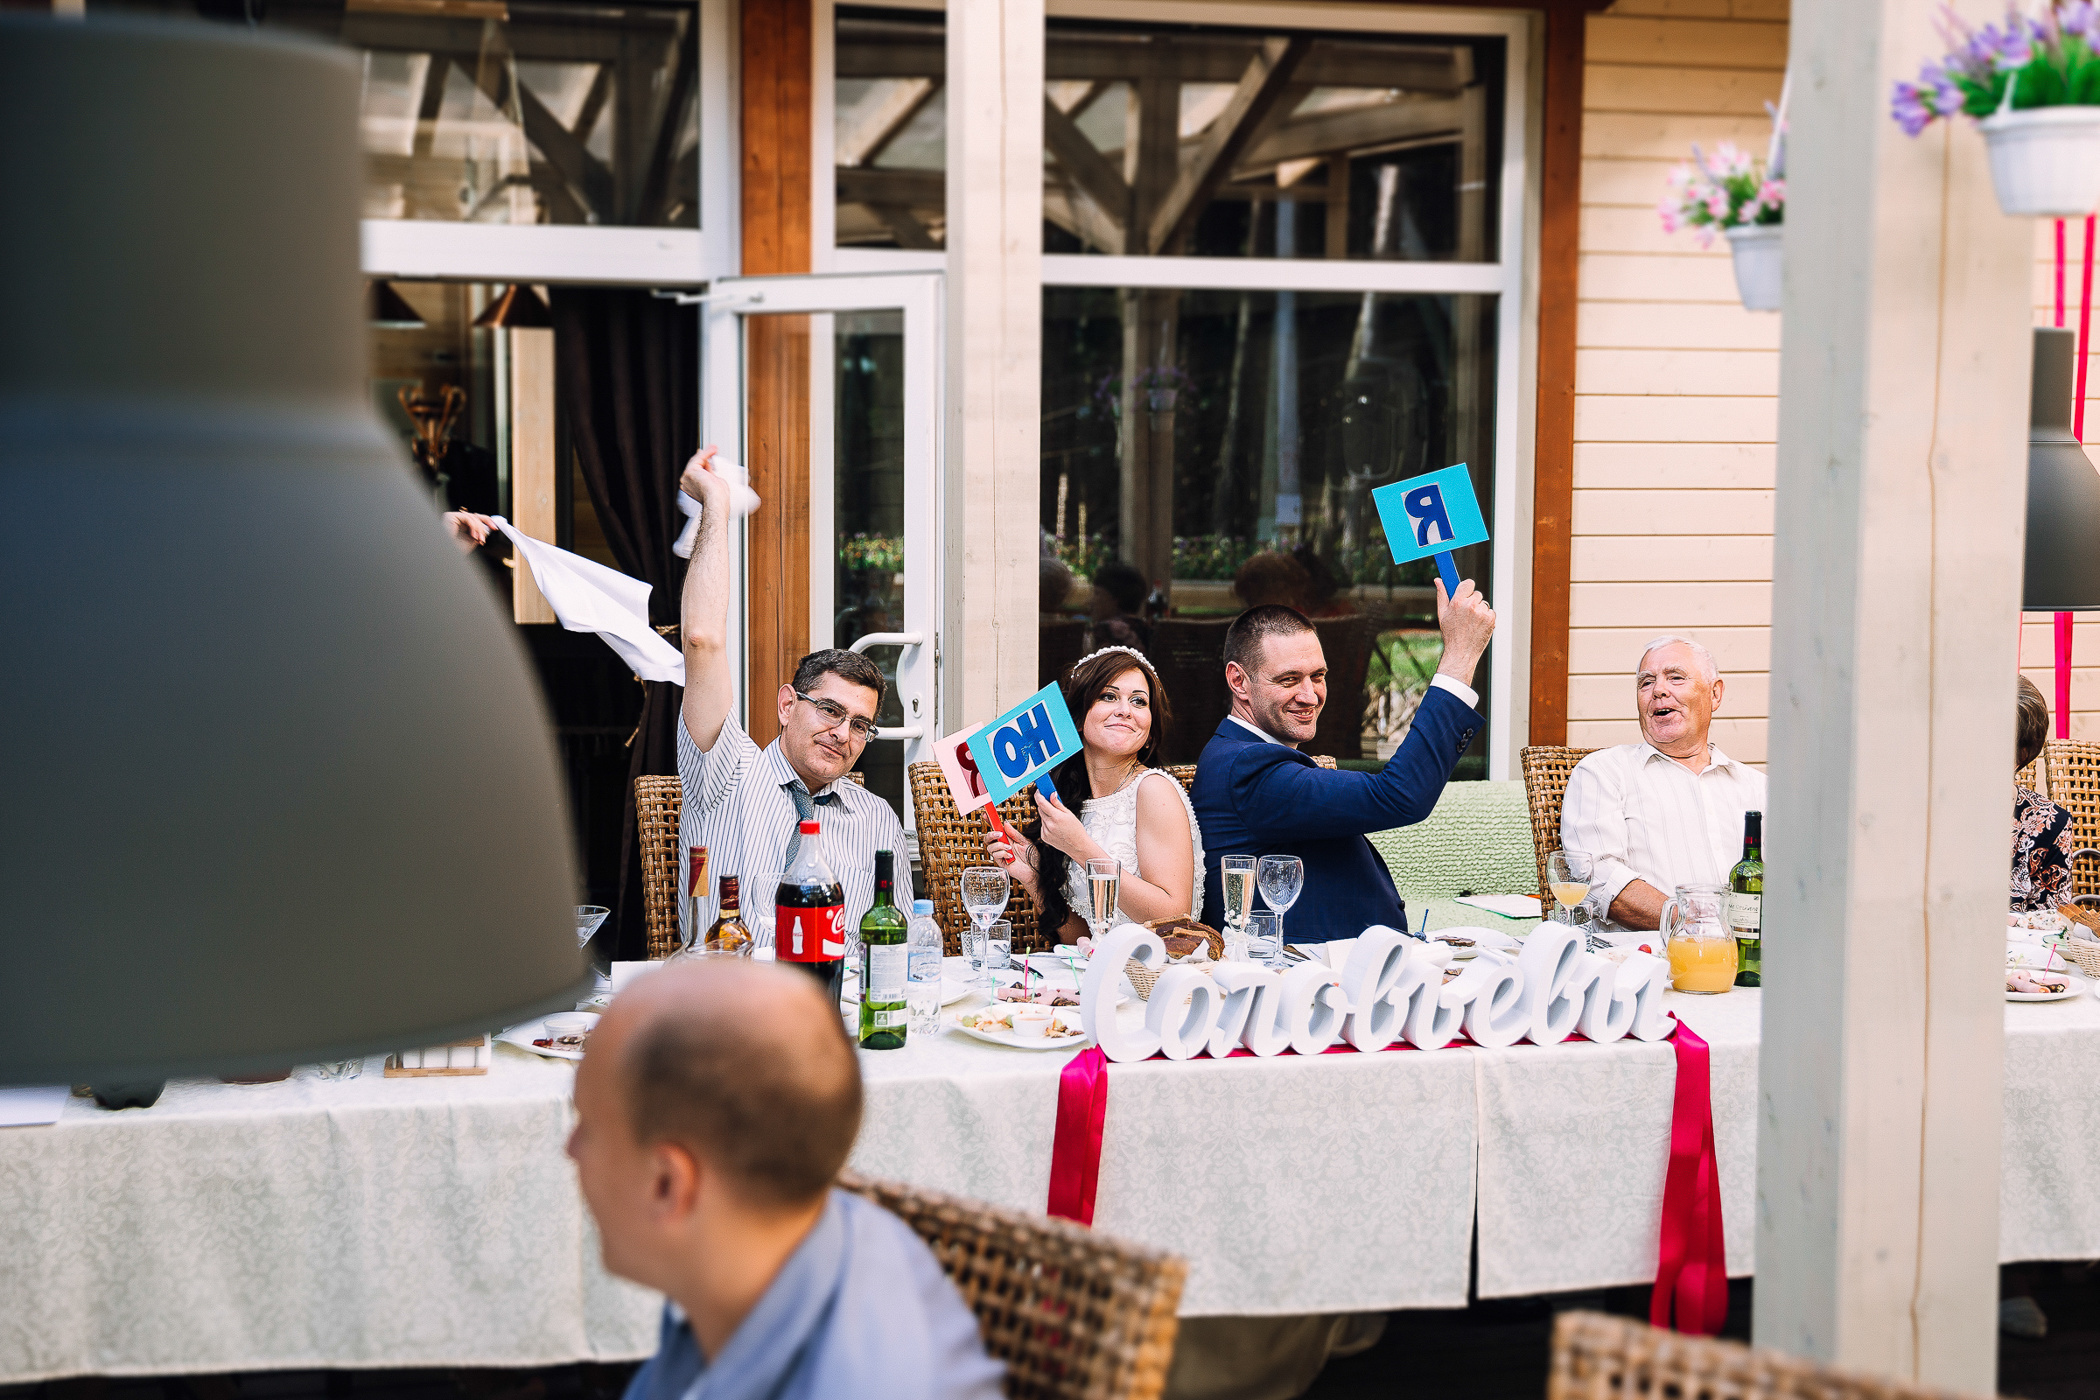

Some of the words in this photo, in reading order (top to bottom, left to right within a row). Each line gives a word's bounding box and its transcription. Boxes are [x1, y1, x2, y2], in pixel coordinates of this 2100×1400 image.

[1404, 484, 1454, 547] Я
[993, 702, 1061, 779] ОН
[1082, 921, 1677, 1063] Соловьевы
